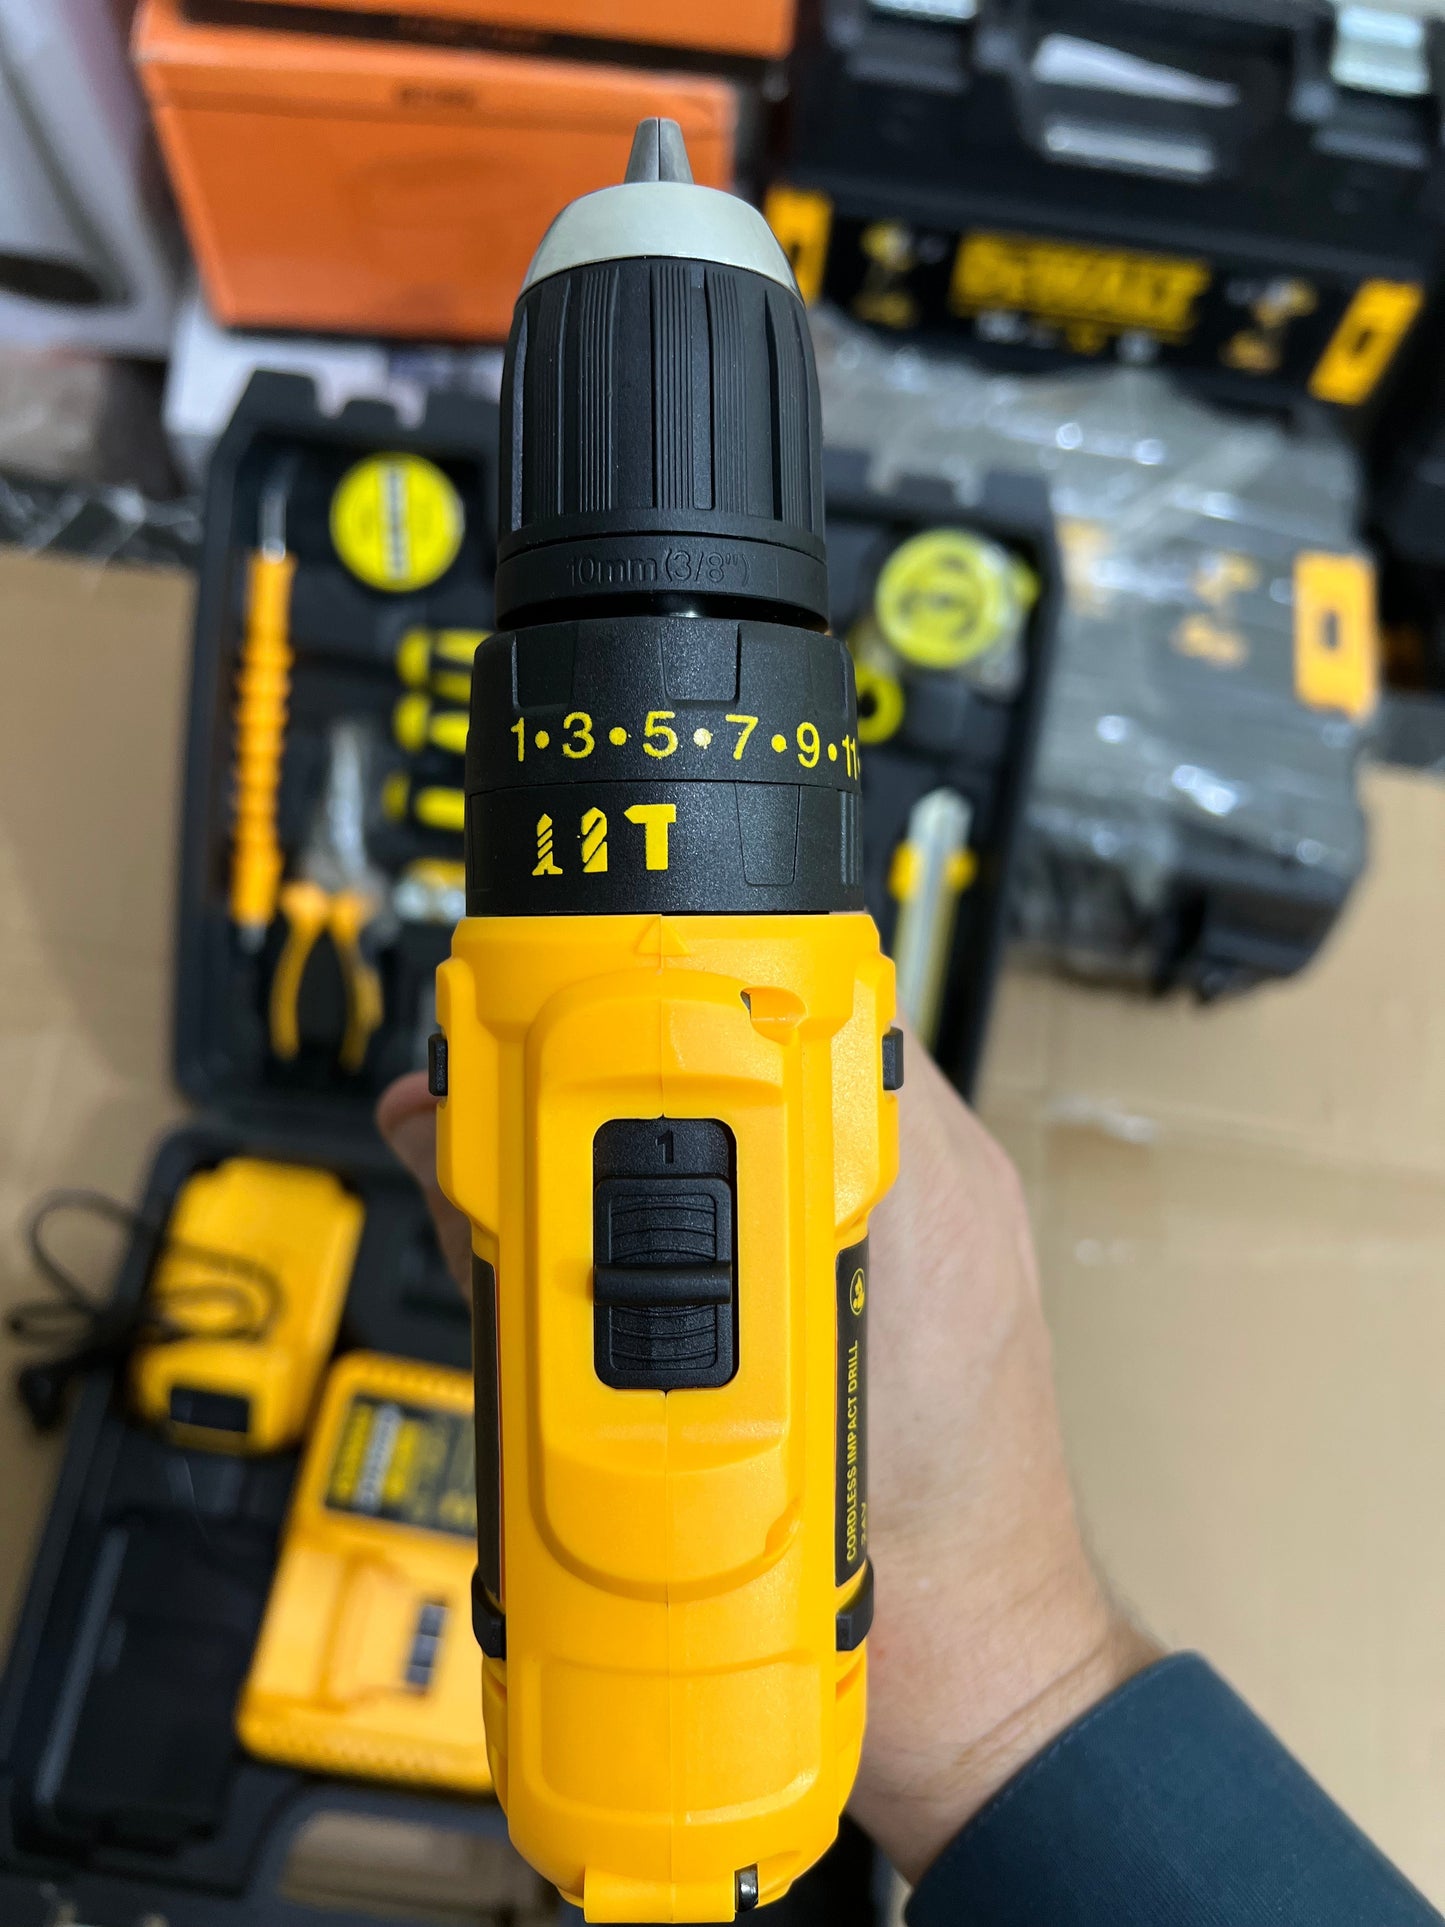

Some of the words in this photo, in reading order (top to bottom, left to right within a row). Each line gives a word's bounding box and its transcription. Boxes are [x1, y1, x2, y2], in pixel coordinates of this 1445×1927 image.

[510, 716, 526, 763] 1
[562, 711, 596, 760] 3
[642, 710, 679, 760] 5
[725, 713, 760, 761] 7
[796, 721, 820, 769] 9
[841, 733, 858, 781] 11
[656, 1129, 674, 1165] 1
[847, 1339, 859, 1394] DRILL
[846, 1396, 858, 1466] IMPACT
[846, 1466, 858, 1563] CORDLESS
